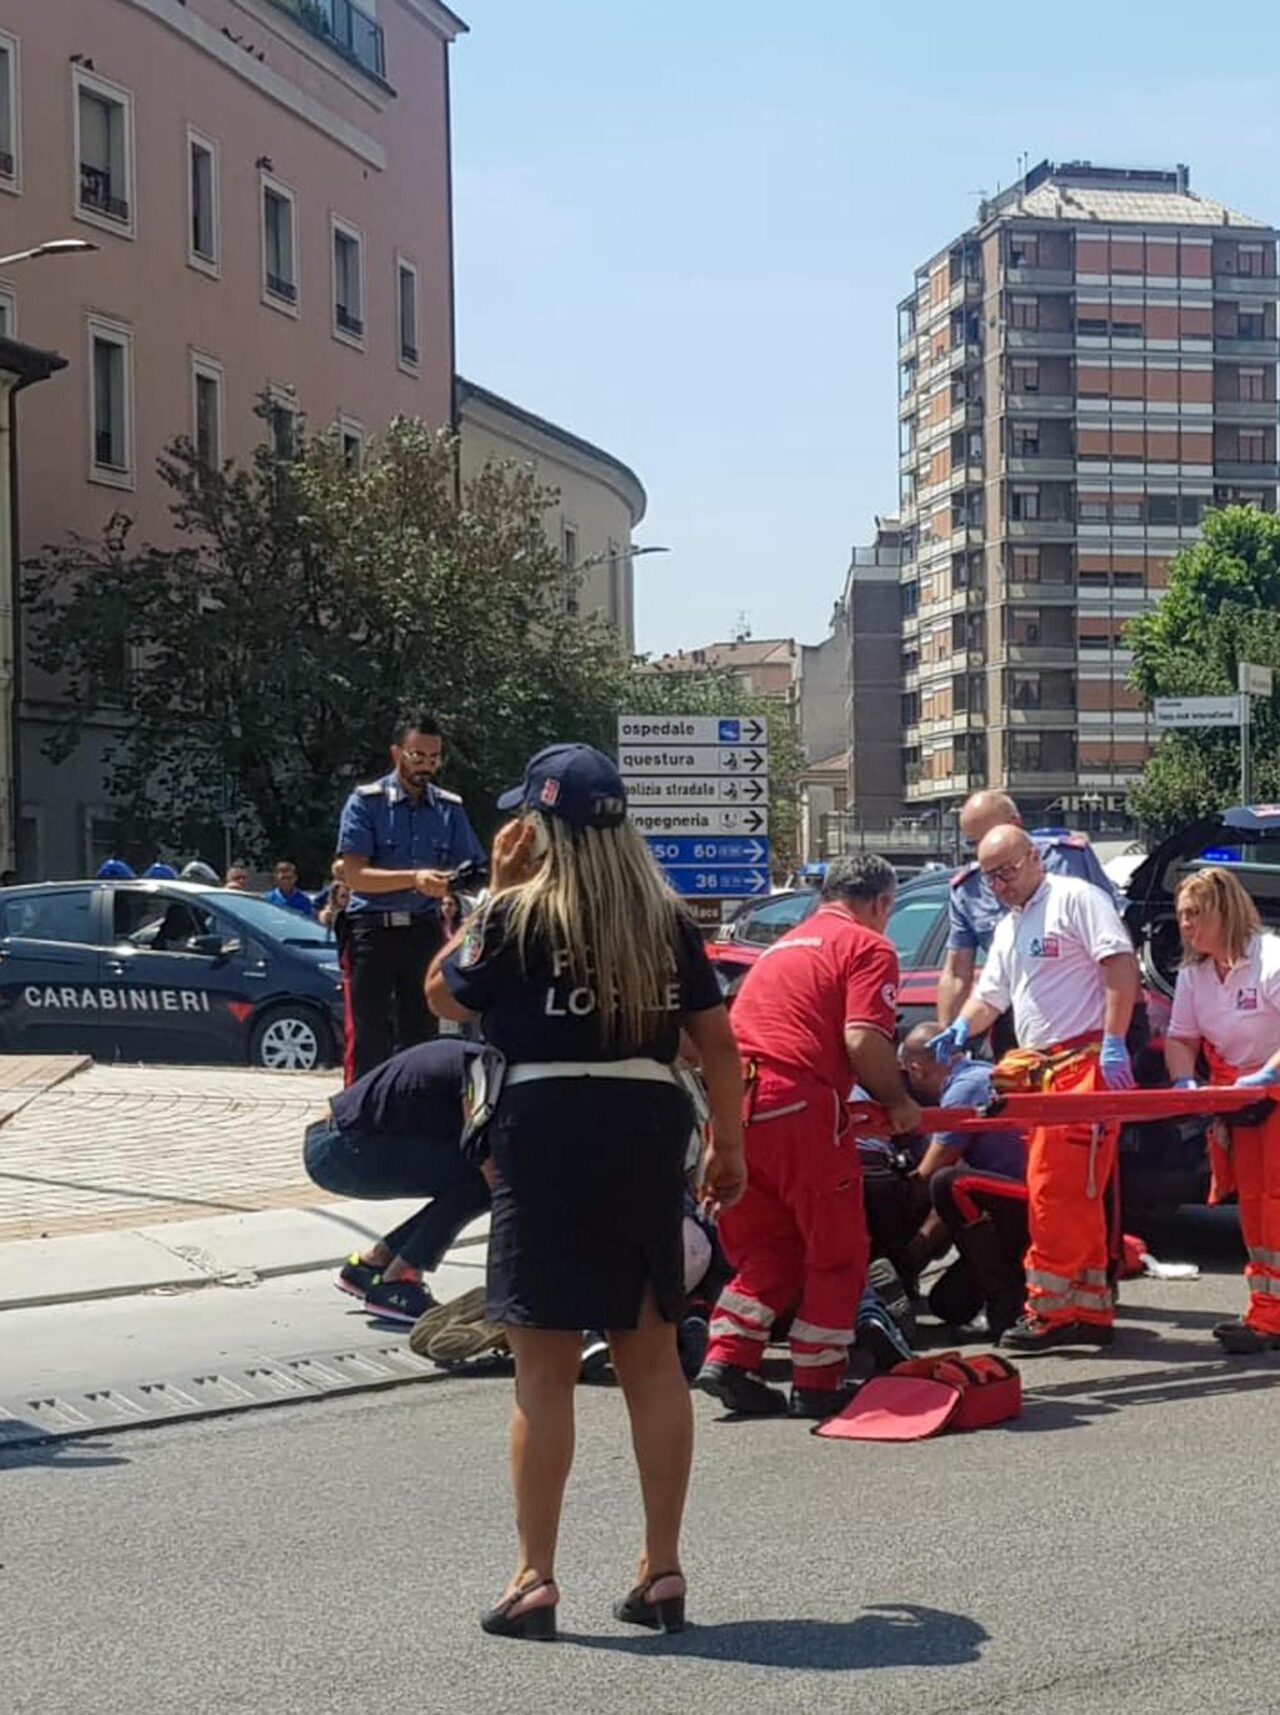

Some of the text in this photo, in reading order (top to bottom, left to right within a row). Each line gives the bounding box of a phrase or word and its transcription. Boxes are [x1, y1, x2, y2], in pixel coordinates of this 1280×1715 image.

[622, 721, 695, 737] ospedale
[623, 753, 695, 768] questura
[666, 782, 715, 796] stradale
[694, 844, 717, 858] 60
[695, 874, 718, 889] 36
[25, 985, 210, 1012] CARABINIERI
